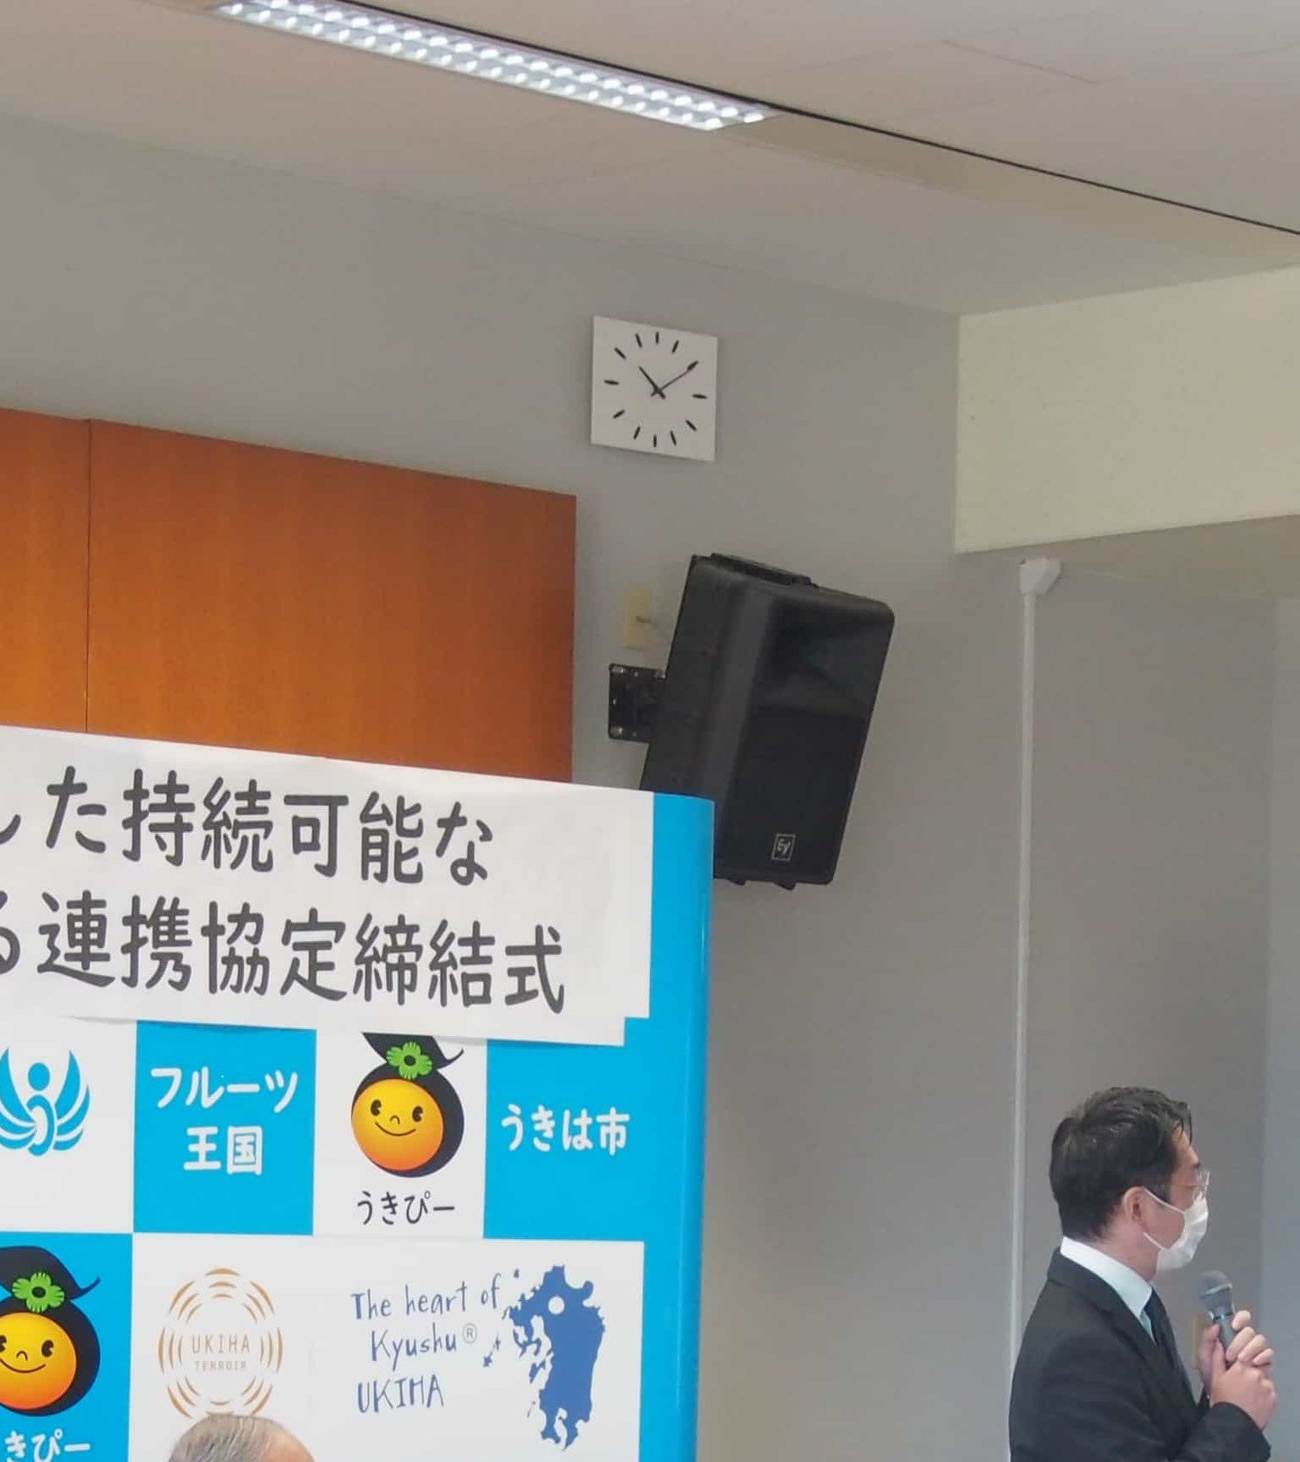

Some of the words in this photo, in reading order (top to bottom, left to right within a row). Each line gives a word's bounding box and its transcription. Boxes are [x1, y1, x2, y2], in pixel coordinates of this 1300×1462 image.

[152, 1067, 297, 1112] フルーツ
[184, 1126, 262, 1174] 王国
[502, 1105, 629, 1154] うきは市
[358, 1191, 454, 1224] うきぴー
[350, 1288, 392, 1320] The
[405, 1281, 468, 1316] heart
[480, 1272, 502, 1309] of
[191, 1333, 251, 1354] UKIHA
[358, 1374, 444, 1413] UKIHA
